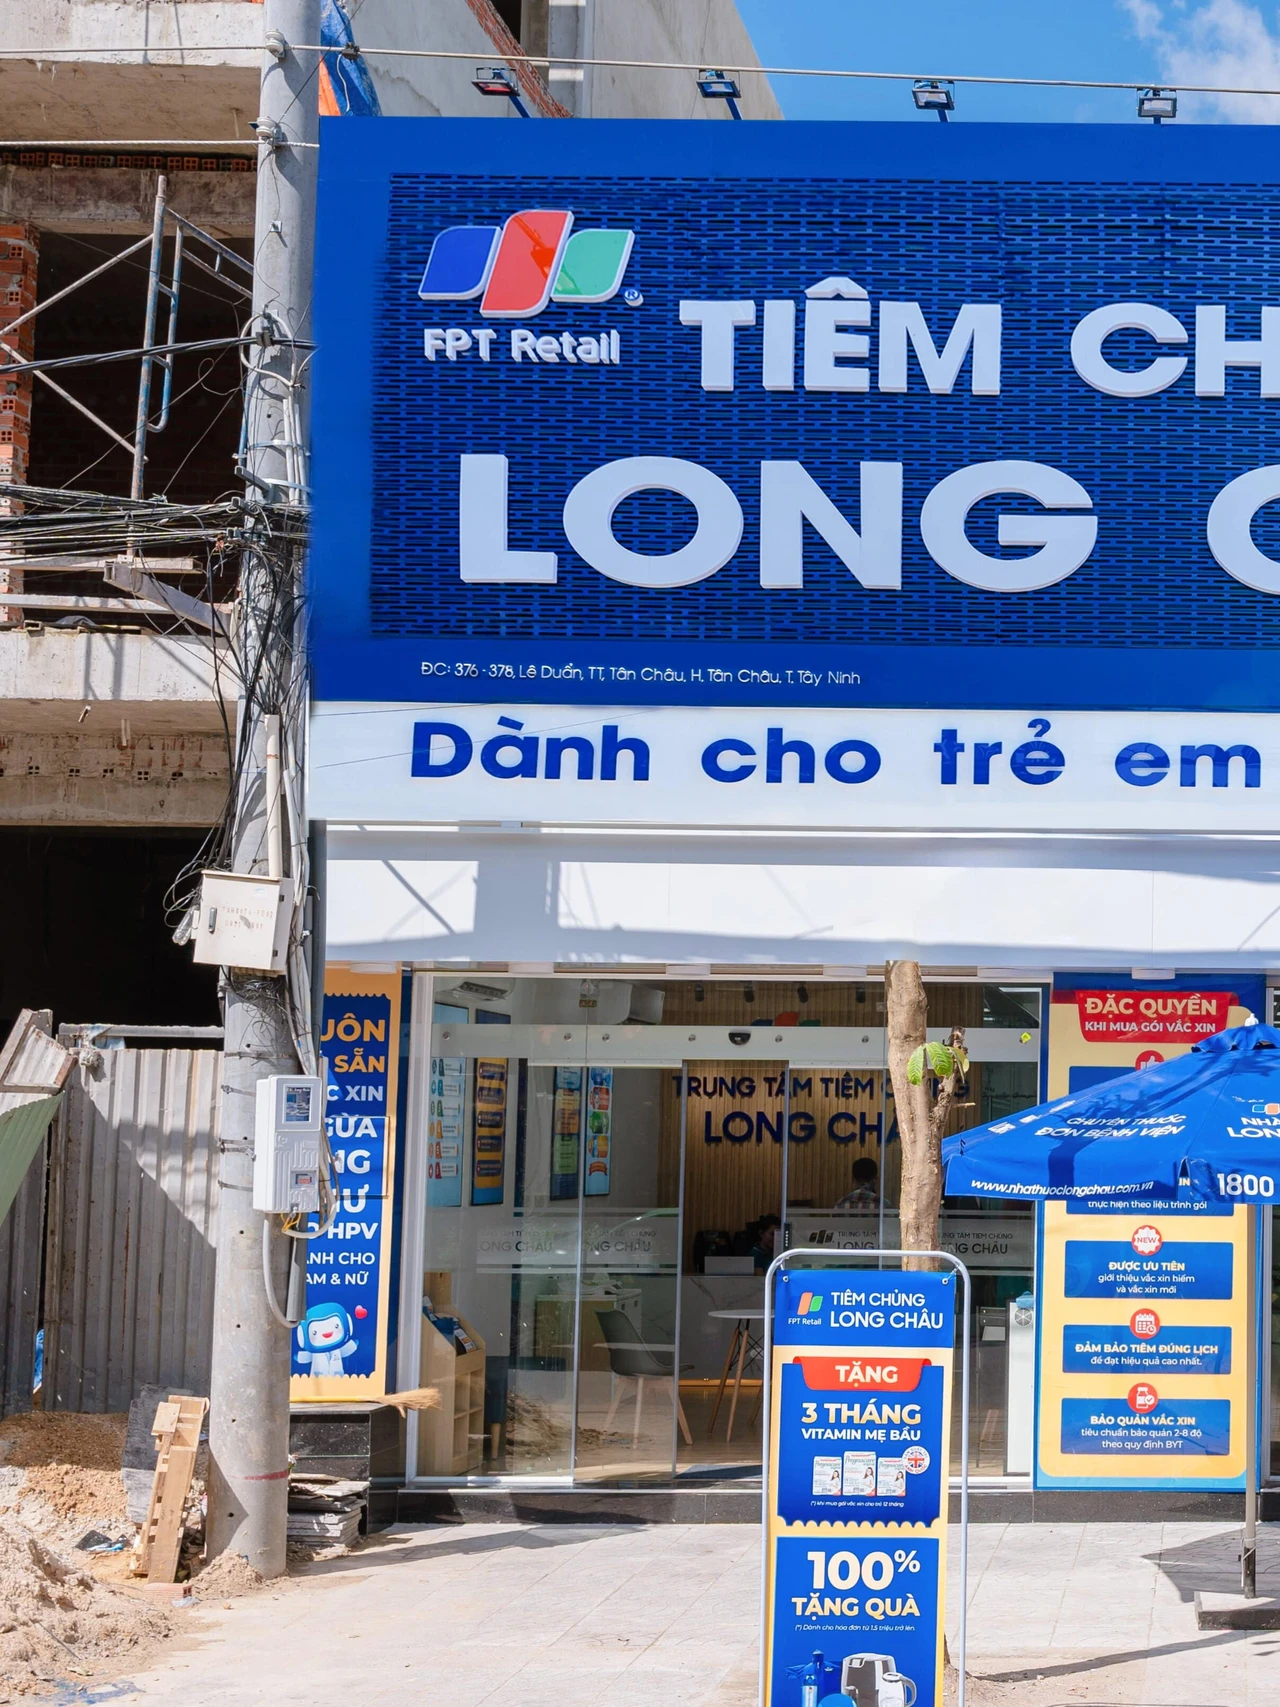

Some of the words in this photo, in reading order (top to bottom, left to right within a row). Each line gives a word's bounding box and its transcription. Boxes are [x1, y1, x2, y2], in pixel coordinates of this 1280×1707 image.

[424, 328, 497, 363] FPT
[511, 328, 621, 364] Retail
[679, 277, 1001, 395] TIÊM
[460, 454, 1098, 592] LONG
[421, 662, 450, 676] ĐC:
[454, 663, 479, 677] 376
[488, 664, 515, 679] 378,
[519, 664, 537, 678] Lê
[541, 662, 584, 681] Duẩn,
[610, 667, 636, 681] Tân
[708, 668, 733, 682] Tân
[797, 670, 822, 686] Tây
[828, 670, 860, 684] Ninh
[411, 715, 650, 781] Dành
[702, 727, 882, 784] cho
[934, 719, 1066, 785] trẻ
[1115, 741, 1262, 788] em
[1085, 993, 1134, 1018] ĐẶC
[1139, 993, 1217, 1017] QUYỀN
[1085, 1020, 1107, 1032] KHI
[1109, 1021, 1138, 1033] MUA
[1141, 1019, 1164, 1033] GÓI
[1165, 1017, 1192, 1033] VẮC
[1194, 1022, 1216, 1033] XIN
[334, 1045, 386, 1073] SẴN
[345, 1085, 383, 1102] XIN
[671, 1074, 757, 1099] TRUNG
[763, 1070, 812, 1098] TÂM
[819, 1070, 875, 1099] TIÊM
[703, 1110, 817, 1145] LONG
[971, 1178, 1154, 1197] www.nhathuoclongchau.com.vn
[1217, 1173, 1275, 1198] 1800
[328, 1221, 378, 1240] HPV
[1137, 1236, 1157, 1244] NEW
[338, 1251, 376, 1266] CHO
[1108, 1261, 1141, 1273] ĐƯỢC
[1143, 1260, 1159, 1271] ƯU
[1161, 1259, 1186, 1271] TIÊN
[344, 1269, 369, 1286] NỮ
[831, 1288, 866, 1307] TIÊM
[869, 1288, 926, 1307] CHỦNG
[788, 1317, 801, 1326] FPT
[802, 1317, 822, 1326] Retail
[830, 1311, 885, 1328] LONG
[889, 1308, 944, 1329] CHÂU
[1075, 1342, 1102, 1354] ĐẢM
[1103, 1342, 1128, 1354] BẢO
[1130, 1342, 1157, 1354] TIÊM
[1159, 1342, 1191, 1354] ĐÚNG
[1193, 1344, 1219, 1356] LỊCH
[835, 1360, 899, 1388] TẶNG
[801, 1402, 818, 1424] 3
[824, 1398, 922, 1426] THÁNG
[801, 1427, 862, 1440] VITAMIN
[864, 1428, 887, 1443] MẸ
[889, 1426, 921, 1441] BẦU
[806, 1549, 921, 1591] 100%
[791, 1592, 859, 1621] TẶNG
[865, 1593, 921, 1621] QUÀ
